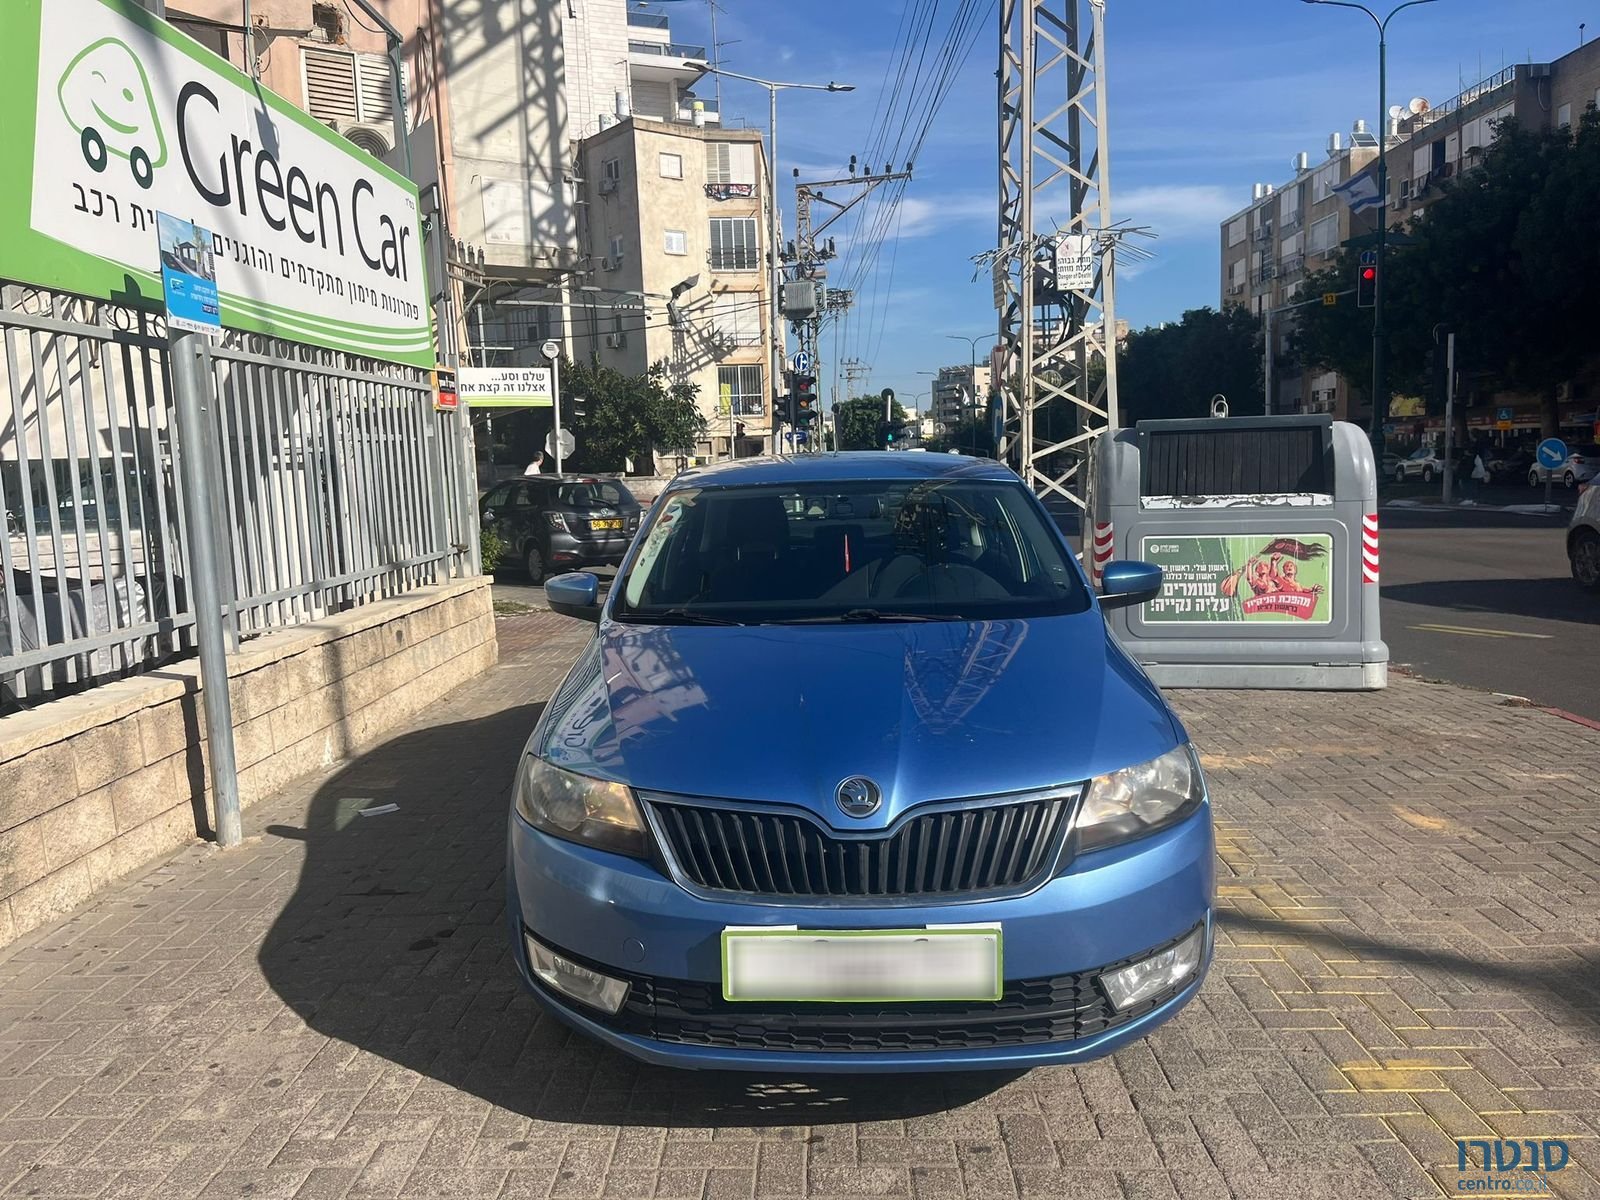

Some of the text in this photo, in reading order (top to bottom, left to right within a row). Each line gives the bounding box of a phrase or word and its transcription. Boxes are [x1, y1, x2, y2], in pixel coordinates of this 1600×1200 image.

[176, 81, 410, 282] Green Car
[72, 182, 120, 223] רכב
[212, 232, 274, 273] והוגנים
[280, 257, 344, 296] מתקדמים
[347, 281, 377, 306] מימון
[1325, 295, 1334, 303] 13
[381, 293, 419, 320] פתרונות
[522, 371, 545, 381] שלם
[460, 382, 546, 394] אצלנו זה קצת אח
[1169, 564, 1190, 573] ראשון
[1183, 572, 1195, 580] של
[1196, 573, 1216, 581] ראשון
[1163, 582, 1217, 596] שומרים
[1150, 596, 1230, 614] עליה נקייה!
[1278, 595, 1312, 607] מהפכת
